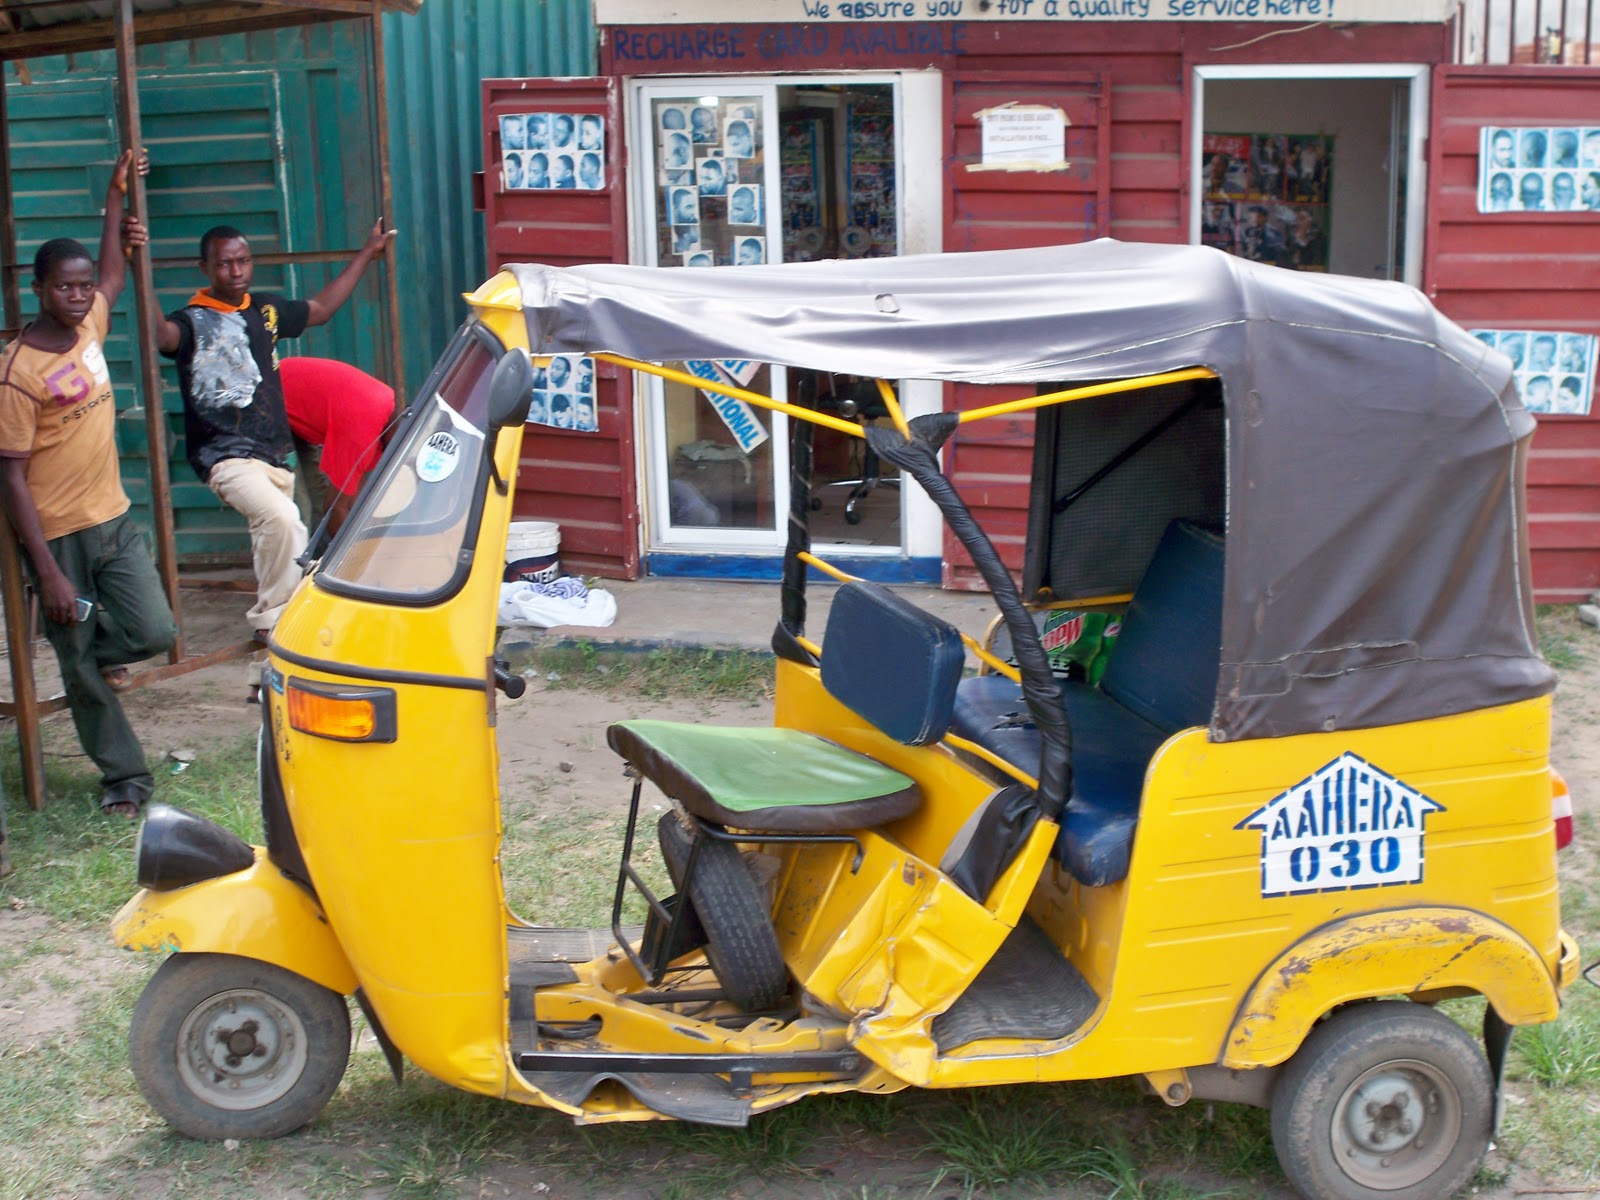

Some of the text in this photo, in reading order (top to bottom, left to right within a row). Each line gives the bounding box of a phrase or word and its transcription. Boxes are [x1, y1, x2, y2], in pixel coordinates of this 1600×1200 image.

[803, 1, 830, 18] We
[926, 1, 963, 17] you
[997, 0, 1034, 15] for
[1044, 0, 1059, 16] a
[1068, 0, 1150, 18] quality
[1167, 0, 1260, 16] service
[613, 28, 746, 60] RECHARGE
[757, 26, 829, 58] CARD
[426, 433, 459, 457] AAHERA
[1270, 765, 1416, 841] AAHERA
[1289, 836, 1401, 883] 030
